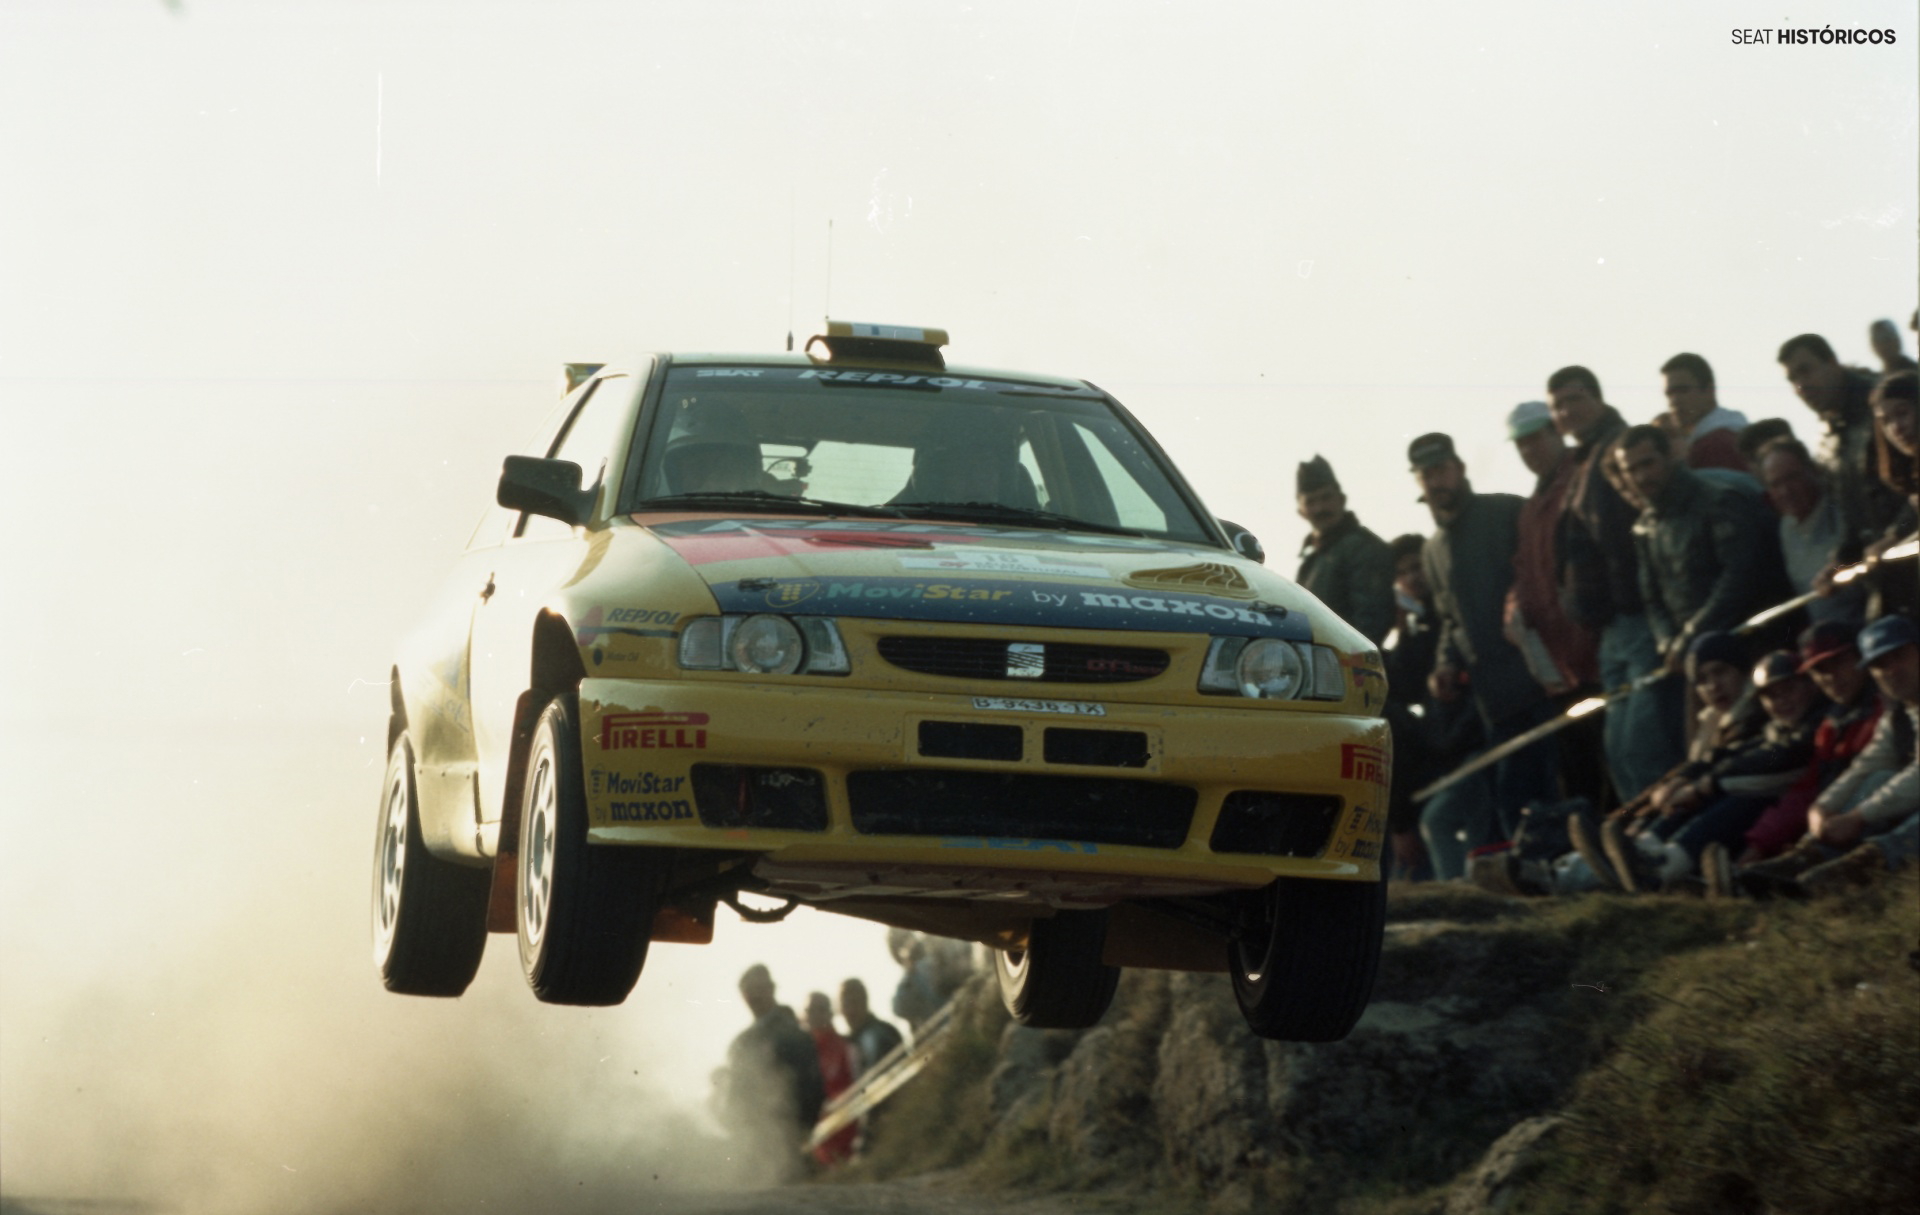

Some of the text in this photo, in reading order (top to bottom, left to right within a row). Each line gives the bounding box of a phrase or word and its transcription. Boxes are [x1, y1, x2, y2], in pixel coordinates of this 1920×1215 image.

[798, 369, 987, 390] REPSOL
[826, 582, 1273, 627] MoviStar by maxon
[606, 607, 681, 626] REPSOL
[601, 711, 711, 751] PIRELLI
[606, 771, 686, 795] MoviStar
[610, 799, 694, 822] maxon
